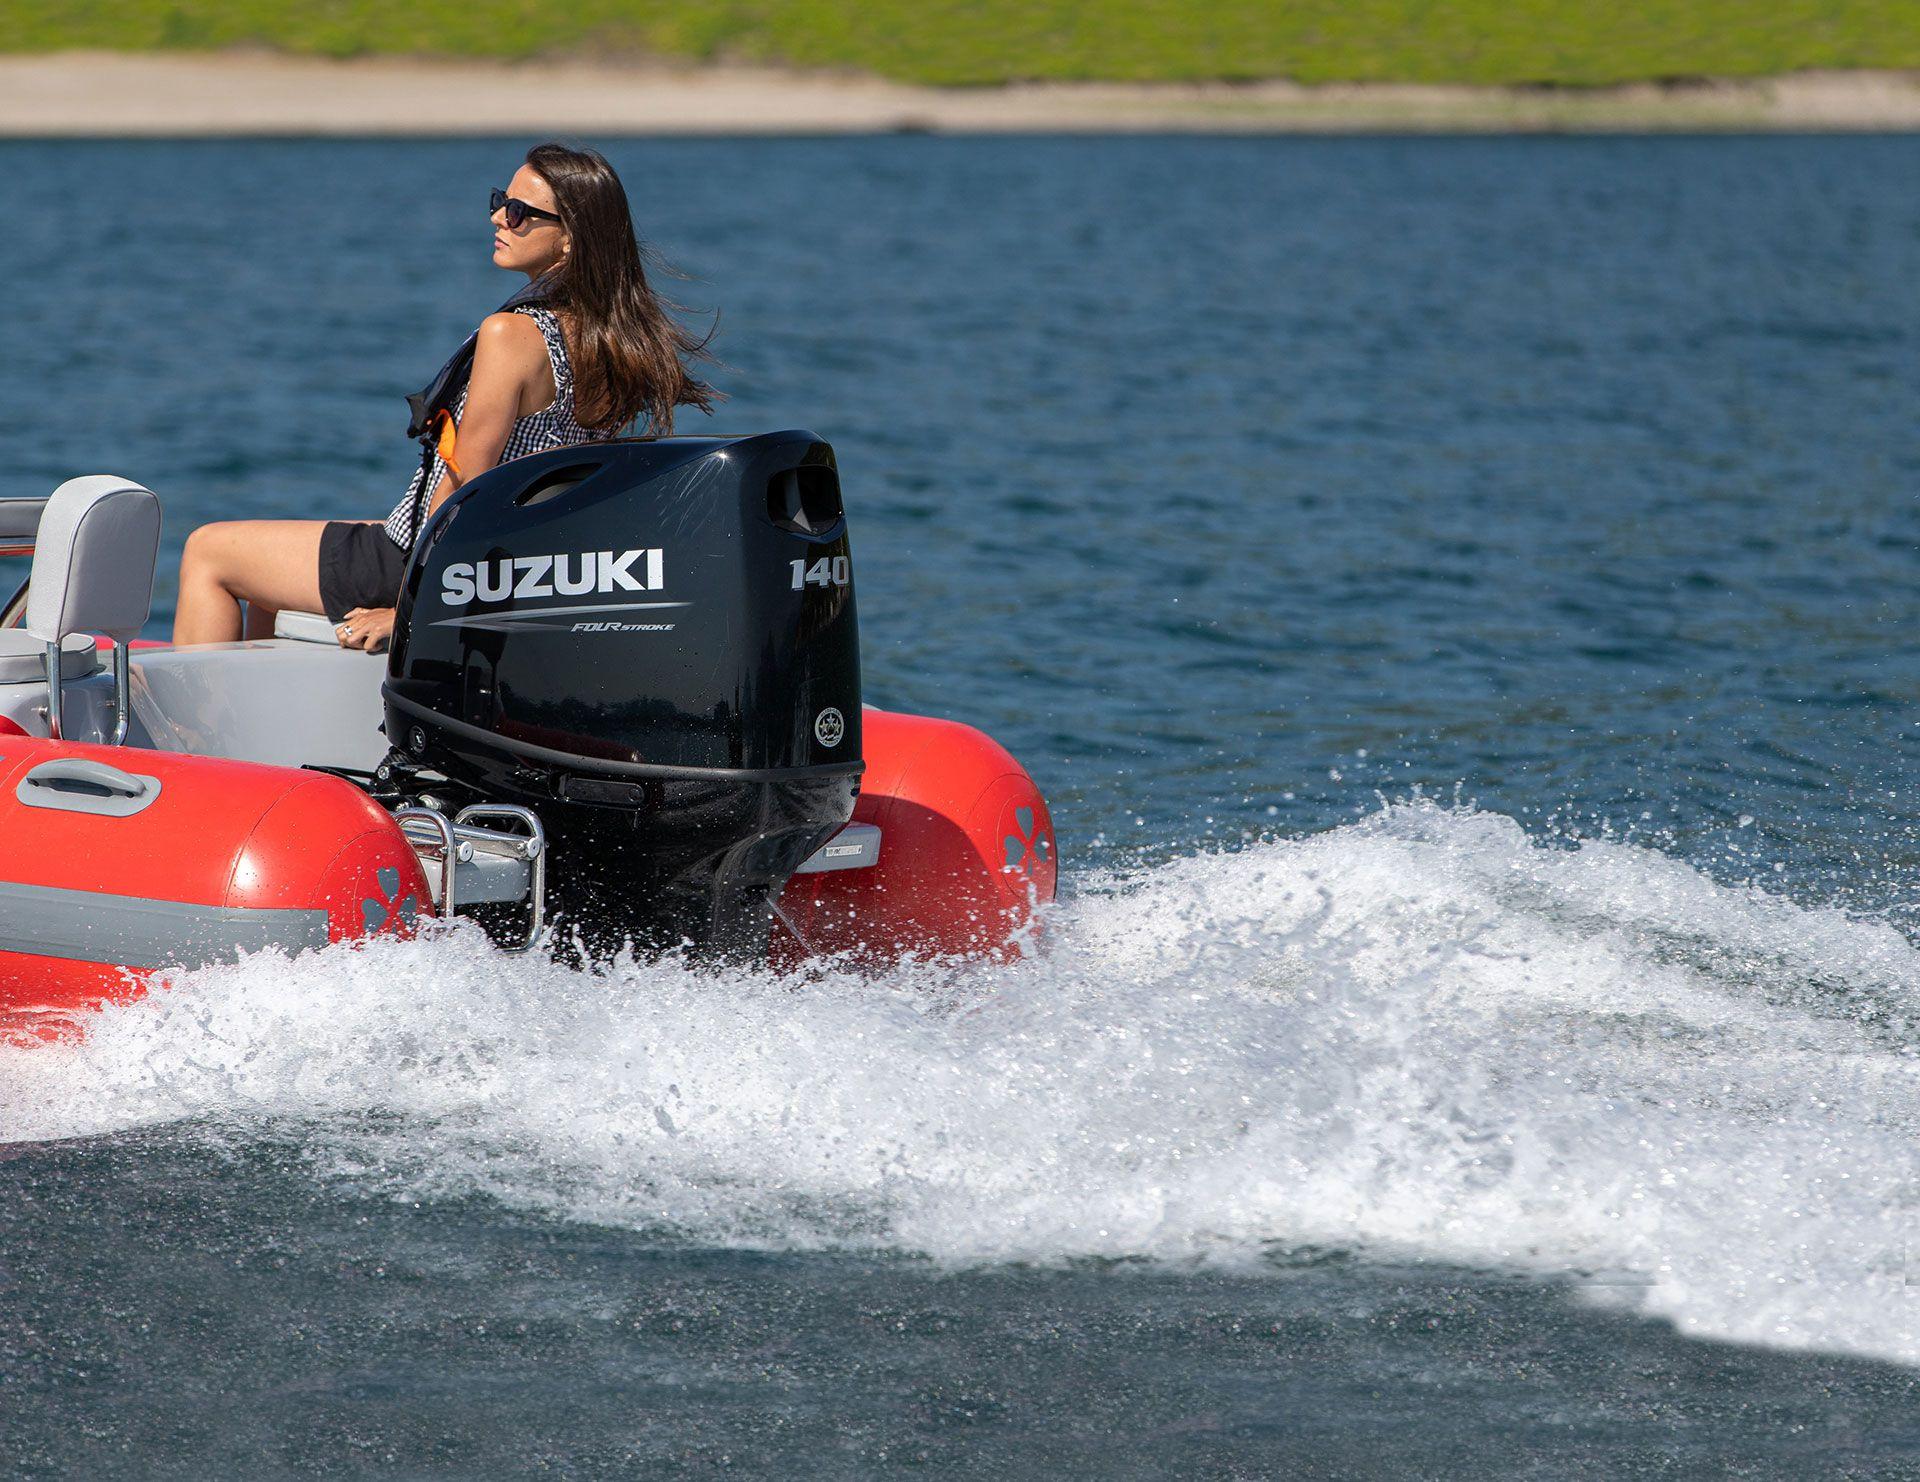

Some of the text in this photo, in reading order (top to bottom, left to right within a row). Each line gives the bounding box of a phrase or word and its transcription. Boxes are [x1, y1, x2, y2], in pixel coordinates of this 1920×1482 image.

[441, 549, 663, 606] SUZUKI
[790, 556, 850, 590] 140
[571, 622, 622, 632] FOUR
